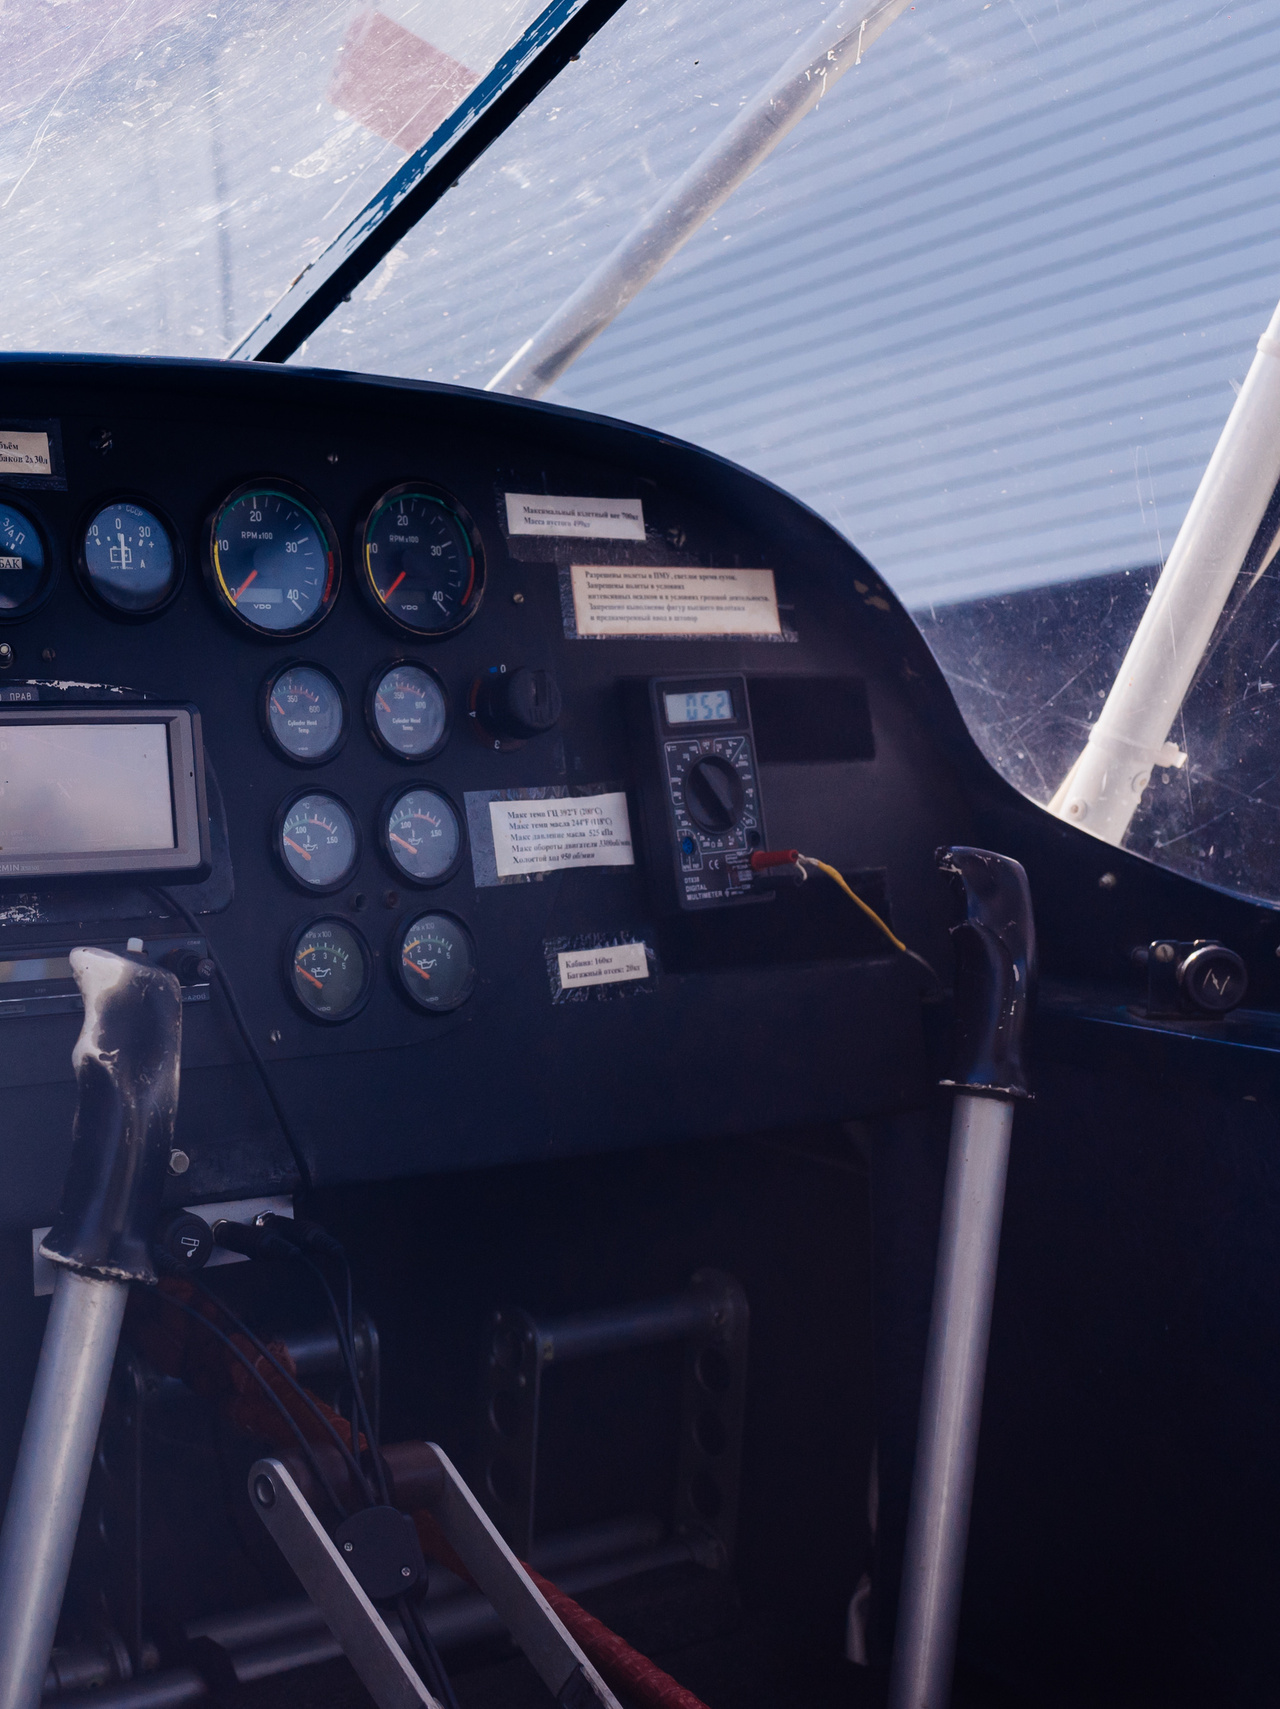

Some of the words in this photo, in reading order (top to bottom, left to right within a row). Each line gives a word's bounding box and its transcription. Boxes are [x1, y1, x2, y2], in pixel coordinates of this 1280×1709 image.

[126, 505, 143, 517] СССР
[249, 511, 262, 522] 20
[397, 515, 409, 526] 20
[524, 517, 545, 525] Масса
[2, 518, 14, 538] 3/4
[115, 518, 122, 529] 0
[139, 526, 151, 538] 30
[241, 531, 257, 539] RPM
[219, 539, 229, 551] 10
[285, 542, 298, 553] 30
[431, 546, 442, 556] 30
[287, 589, 299, 601] 40
[432, 591, 443, 602] 40
[9, 692, 32, 701] ПРАВ
[287, 695, 298, 703] 350
[507, 811, 528, 819] Макс
[295, 826, 307, 834] 100
[326, 836, 338, 844] 150
[511, 845, 532, 853] Макс
[512, 855, 547, 864] Холостой
[685, 884, 707, 893] DIGITAL
[686, 890, 723, 901] MULTIMETER
[567, 971, 602, 980] Багажный
